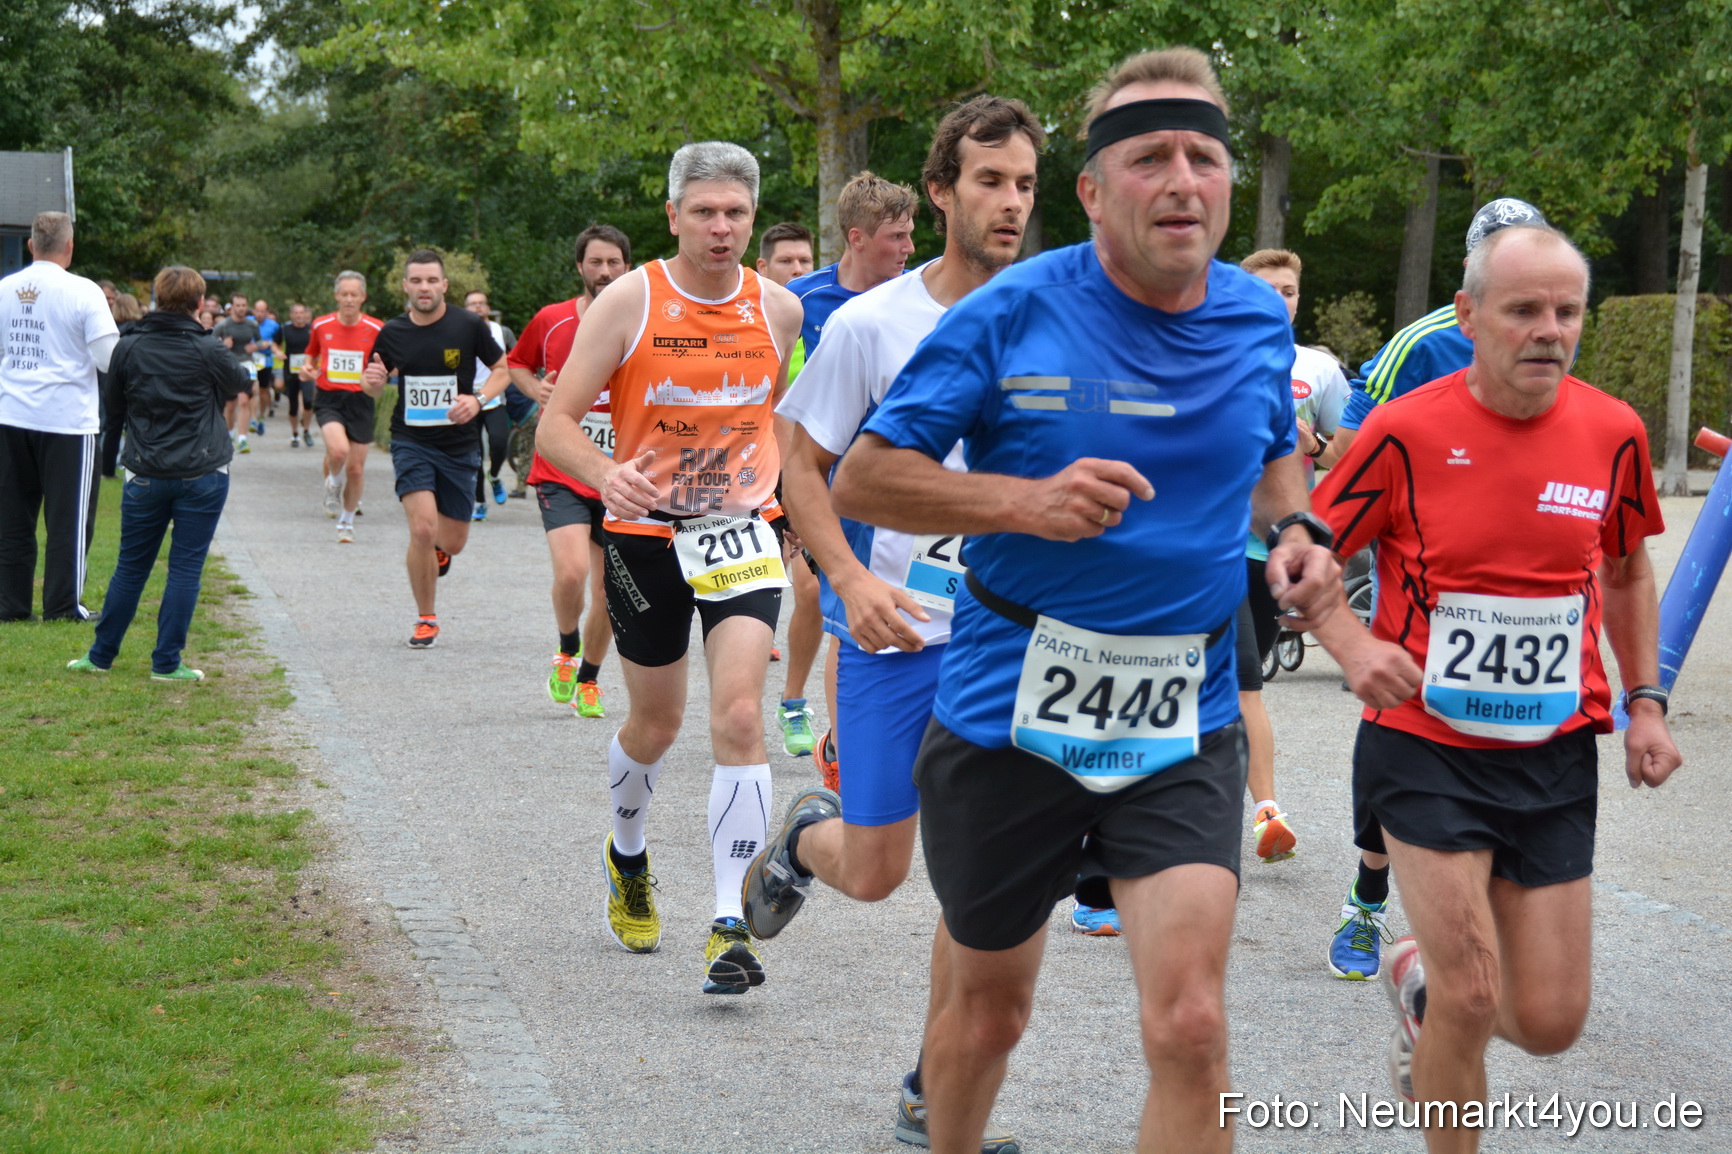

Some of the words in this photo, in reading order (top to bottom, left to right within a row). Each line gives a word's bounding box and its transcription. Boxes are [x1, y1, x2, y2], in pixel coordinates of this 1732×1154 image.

[21, 305, 33, 315] IM
[10, 318, 45, 331] UFTRAG
[9, 332, 41, 344] SEINER
[655, 338, 676, 347] LIFE
[677, 339, 705, 347] PARK
[671, 348, 689, 356] MAX
[714, 351, 742, 359] Audi
[745, 350, 765, 359] BKK
[12, 359, 39, 371] JESUS
[332, 357, 356, 371] 515
[409, 388, 453, 407] 3074
[1290, 385, 1309, 395] ervis
[679, 447, 730, 473] RUN
[671, 472, 695, 486] FOR
[697, 472, 732, 487] YOUR
[1538, 481, 1606, 510] JURA
[1536, 503, 1601, 521] SPORT-Service
[698, 521, 763, 567] 201
[610, 546, 626, 572] LIFE
[621, 573, 646, 608] PARK
[711, 564, 769, 589] Thorsten
[1434, 605, 1487, 623] PARTL
[1491, 611, 1562, 626] Neumarkt
[1034, 633, 1094, 663] PARTL
[1098, 650, 1180, 668] Neumarkt
[1443, 628, 1569, 686] 2432
[1036, 664, 1188, 731] 2448
[1465, 696, 1543, 721] Herbert
[1061, 743, 1146, 770] Werner
[730, 850, 753, 859] cep
